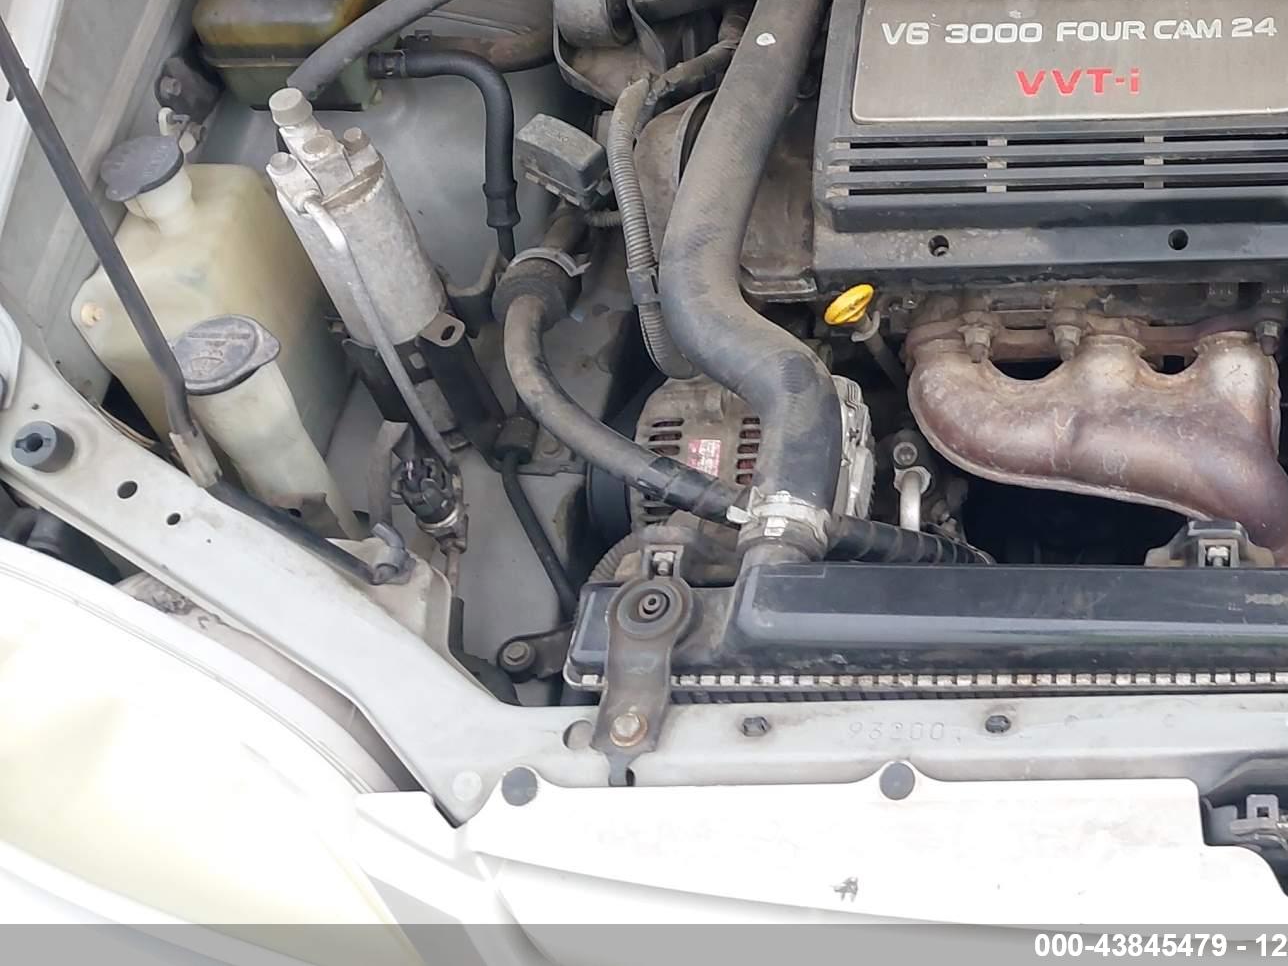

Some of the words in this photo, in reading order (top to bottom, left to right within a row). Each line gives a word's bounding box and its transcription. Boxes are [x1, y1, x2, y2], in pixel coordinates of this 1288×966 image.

[882, 22, 930, 44] V6
[945, 23, 1043, 43] 3000
[1056, 20, 1146, 42] FOUR
[1153, 18, 1223, 40] CAM
[1231, 16, 1278, 38] 24
[1015, 66, 1142, 97] VVT-i
